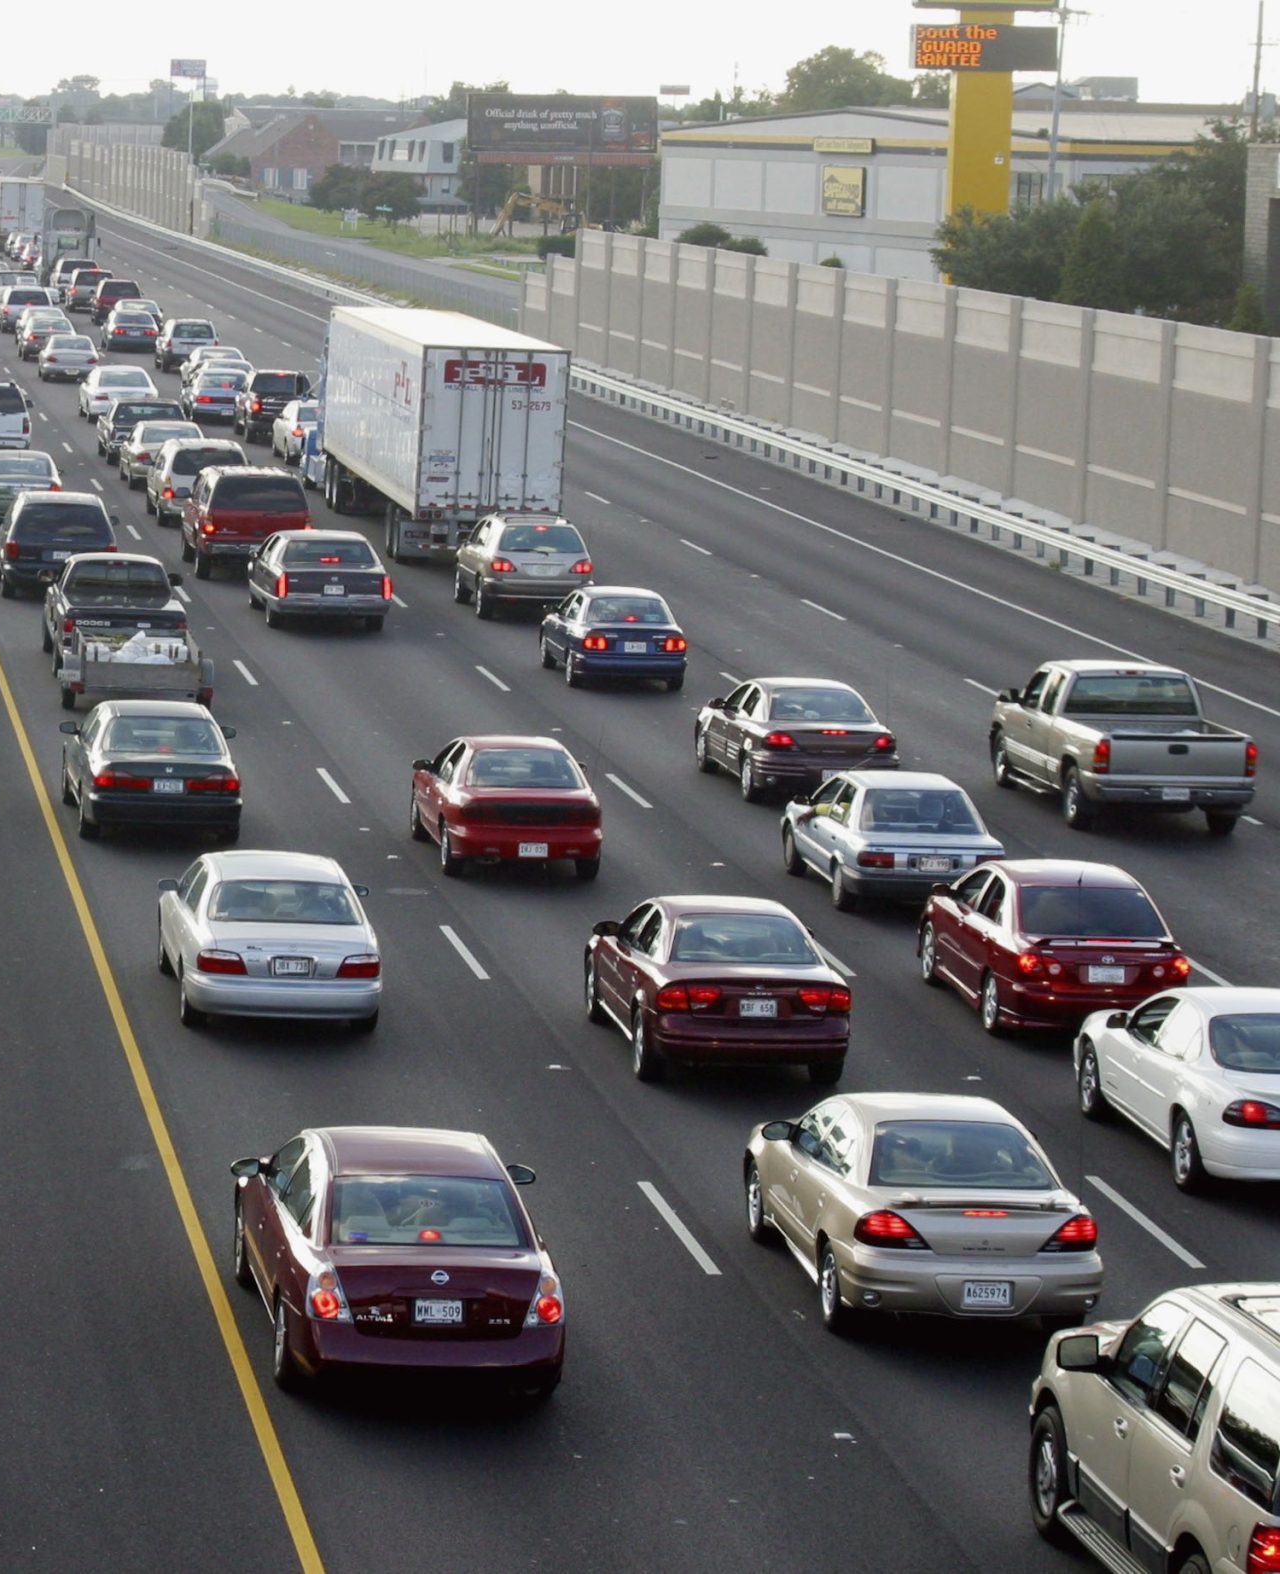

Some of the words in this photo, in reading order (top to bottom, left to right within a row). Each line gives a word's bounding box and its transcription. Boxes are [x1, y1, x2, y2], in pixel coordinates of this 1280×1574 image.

[965, 25, 999, 39] the
[485, 108, 515, 119] Official
[516, 108, 538, 119] drink
[539, 108, 550, 119] of
[550, 109, 573, 121] pretty
[575, 110, 598, 120] much
[393, 360, 412, 406] PTL
[511, 400, 551, 411] 53-2679
[75, 619, 111, 627] DODGE
[966, 1287, 1007, 1299] A625974
[442, 1305, 461, 1318] 509
